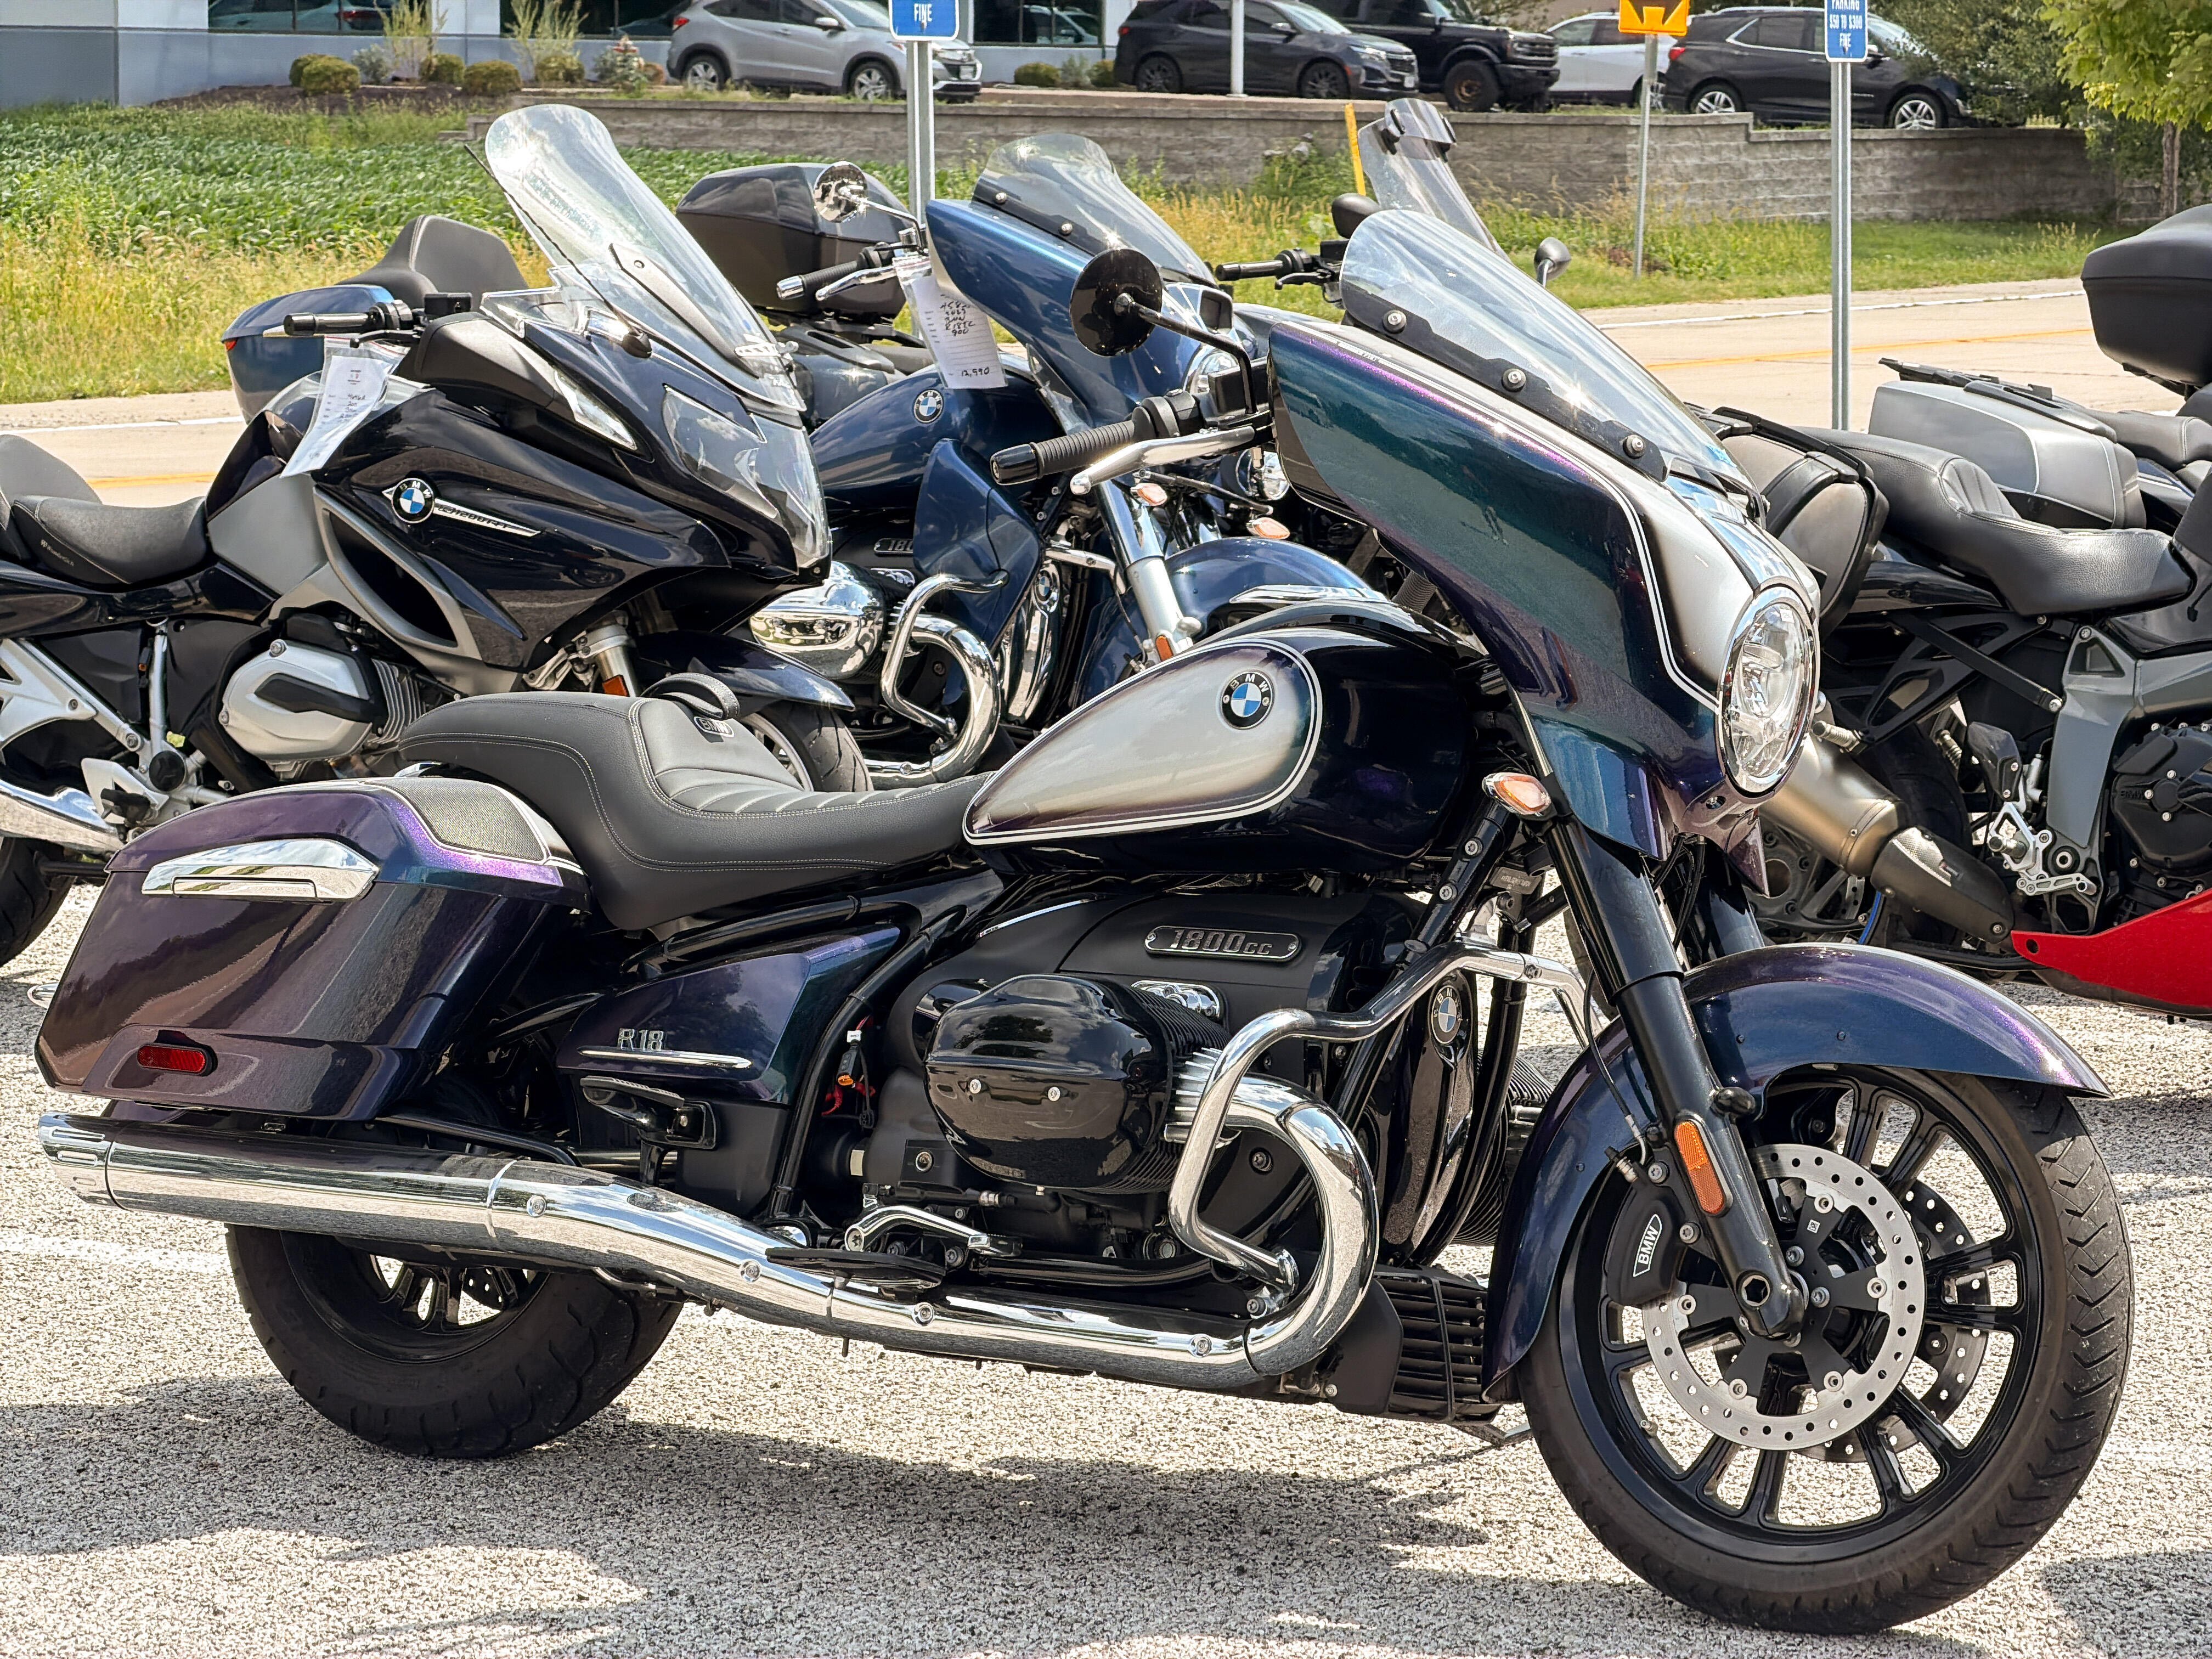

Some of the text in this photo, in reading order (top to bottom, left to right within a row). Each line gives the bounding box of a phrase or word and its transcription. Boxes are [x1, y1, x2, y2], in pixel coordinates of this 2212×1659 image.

[914, 3, 933, 22] FINE
[1830, 14, 1863, 30] $50 TO $300
[1839, 33, 1852, 48] FINE
[918, 391, 941, 402] BMW
[399, 481, 432, 499] BMW
[1229, 674, 1269, 692] BMW
[698, 719, 729, 734] BMW
[1638, 1225, 1659, 1265] BMW
